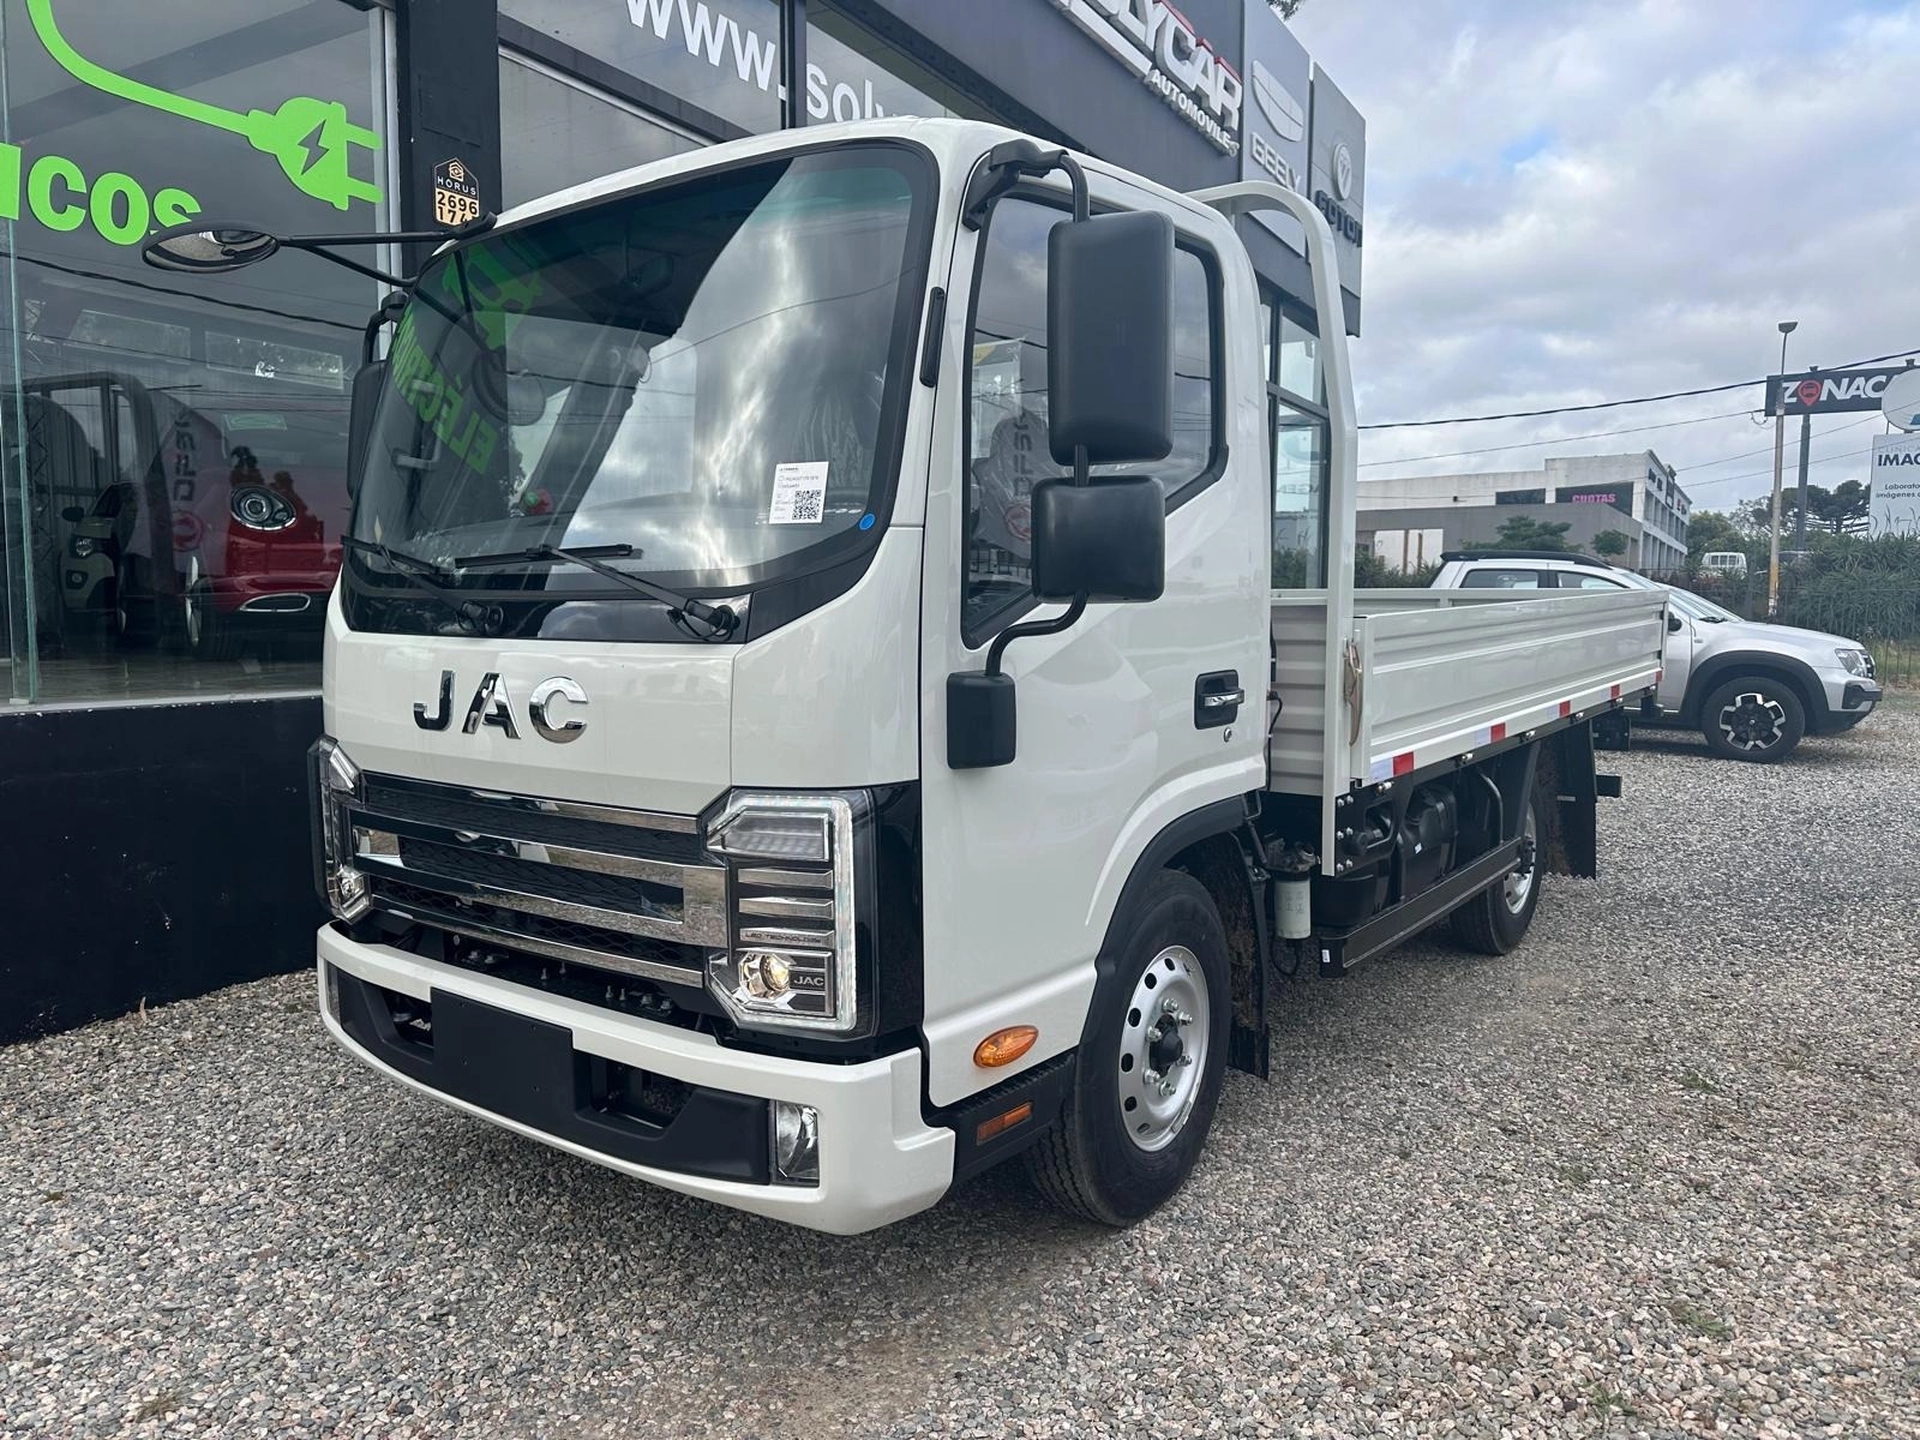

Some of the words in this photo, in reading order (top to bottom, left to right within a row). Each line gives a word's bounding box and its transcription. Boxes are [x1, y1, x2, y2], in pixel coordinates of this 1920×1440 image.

[1084, 0, 1242, 131] LYCAR
[1149, 68, 1239, 158] AUTOMOVILES
[437, 176, 477, 195] HORUS
[1251, 132, 1301, 193] GEELY
[437, 191, 477, 215] 2696
[1782, 374, 1899, 406] ZONAC
[413, 669, 589, 744] JAC
[793, 976, 825, 986] JAC
